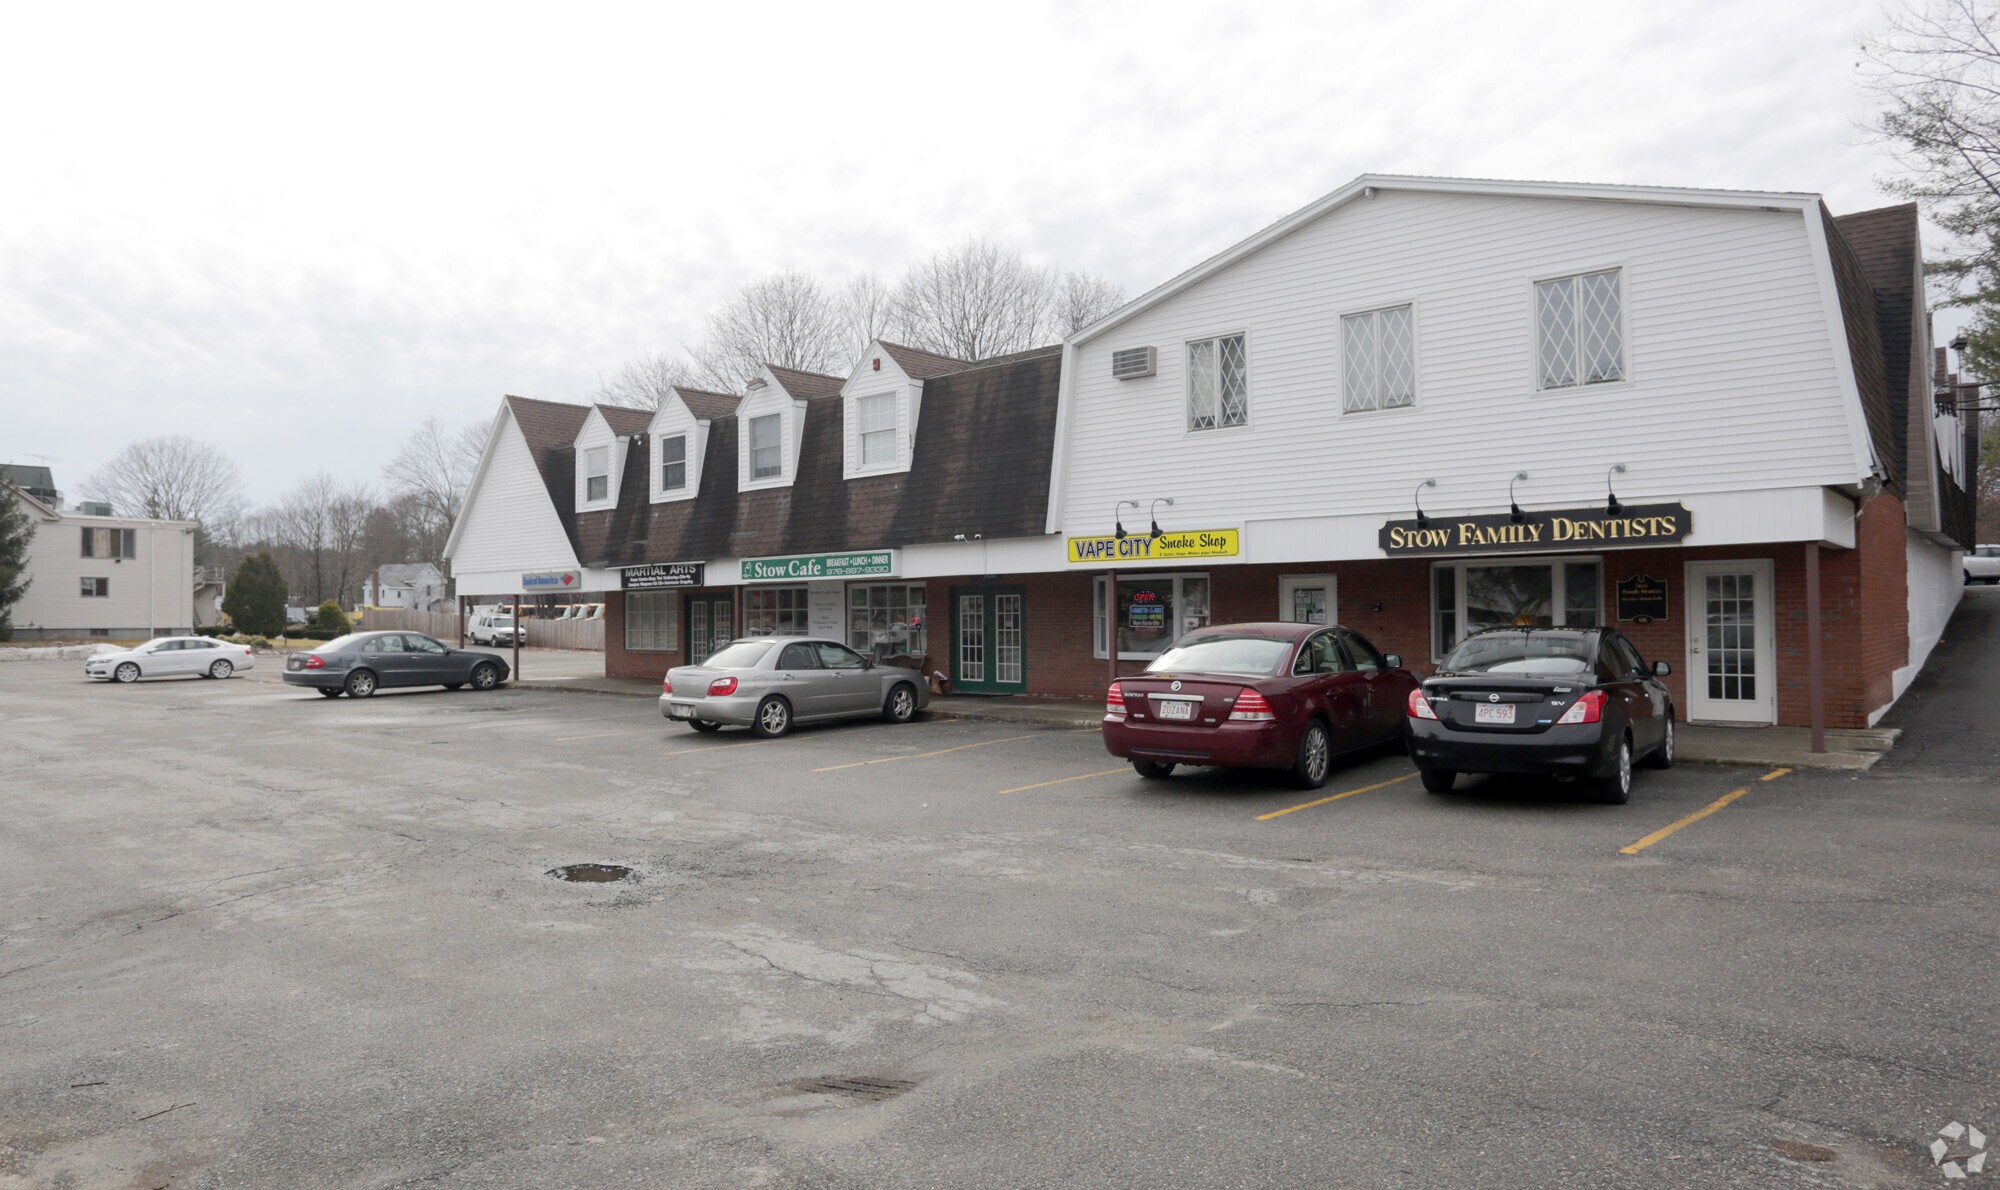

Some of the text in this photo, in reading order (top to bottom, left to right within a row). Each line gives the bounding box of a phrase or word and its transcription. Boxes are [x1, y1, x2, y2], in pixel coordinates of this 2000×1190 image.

[1390, 516, 1677, 549] STOW FAMILY DENTISTS
[1075, 537, 1153, 559] VAPE CITY
[1159, 533, 1226, 550] Smoke Shop
[754, 559, 821, 578] Stow Cafe
[826, 555, 889, 568] BREAKFAST LUNCH DINNER
[625, 565, 667, 578] MARTIAL
[669, 563, 697, 575] ARTS
[1133, 593, 1156, 601] OPEN
[1161, 704, 1189, 715] ZUZANA
[1496, 708, 1513, 719] 593
